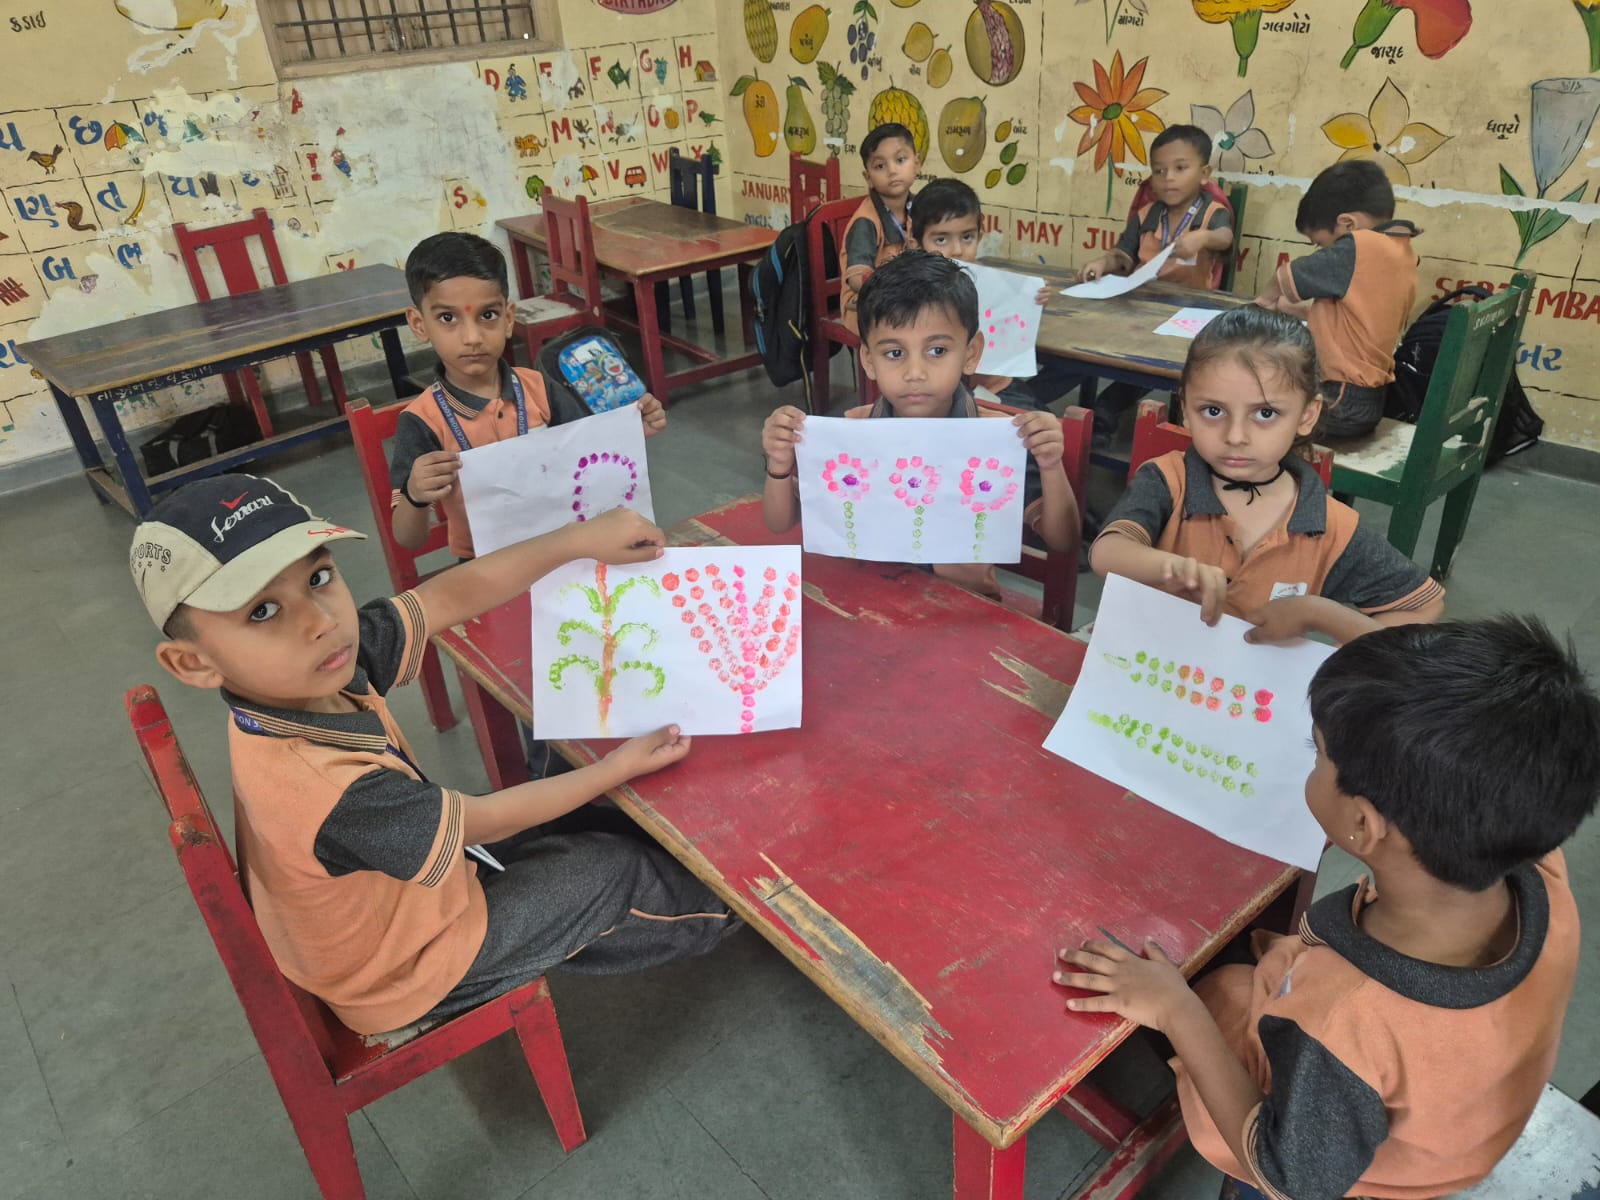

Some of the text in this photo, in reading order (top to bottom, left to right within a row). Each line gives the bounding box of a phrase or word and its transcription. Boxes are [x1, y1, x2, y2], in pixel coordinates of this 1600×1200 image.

[1262, 12, 1311, 34] ગલગોટો
[590, 56, 602, 80] F
[640, 49, 653, 72] G
[679, 45, 692, 68] H
[484, 69, 500, 91] D
[686, 99, 698, 123] P
[69, 115, 103, 145] છ
[551, 117, 572, 143] M
[607, 160, 620, 180] V
[652, 151, 669, 173] W
[97, 181, 128, 212] ત
[453, 186, 469, 209] S
[741, 180, 791, 204] JANUAR
[14, 194, 60, 228] ણ
[980, 213, 1002, 233] RIL
[1017, 219, 1063, 247] MAY
[1083, 227, 1116, 251] JU
